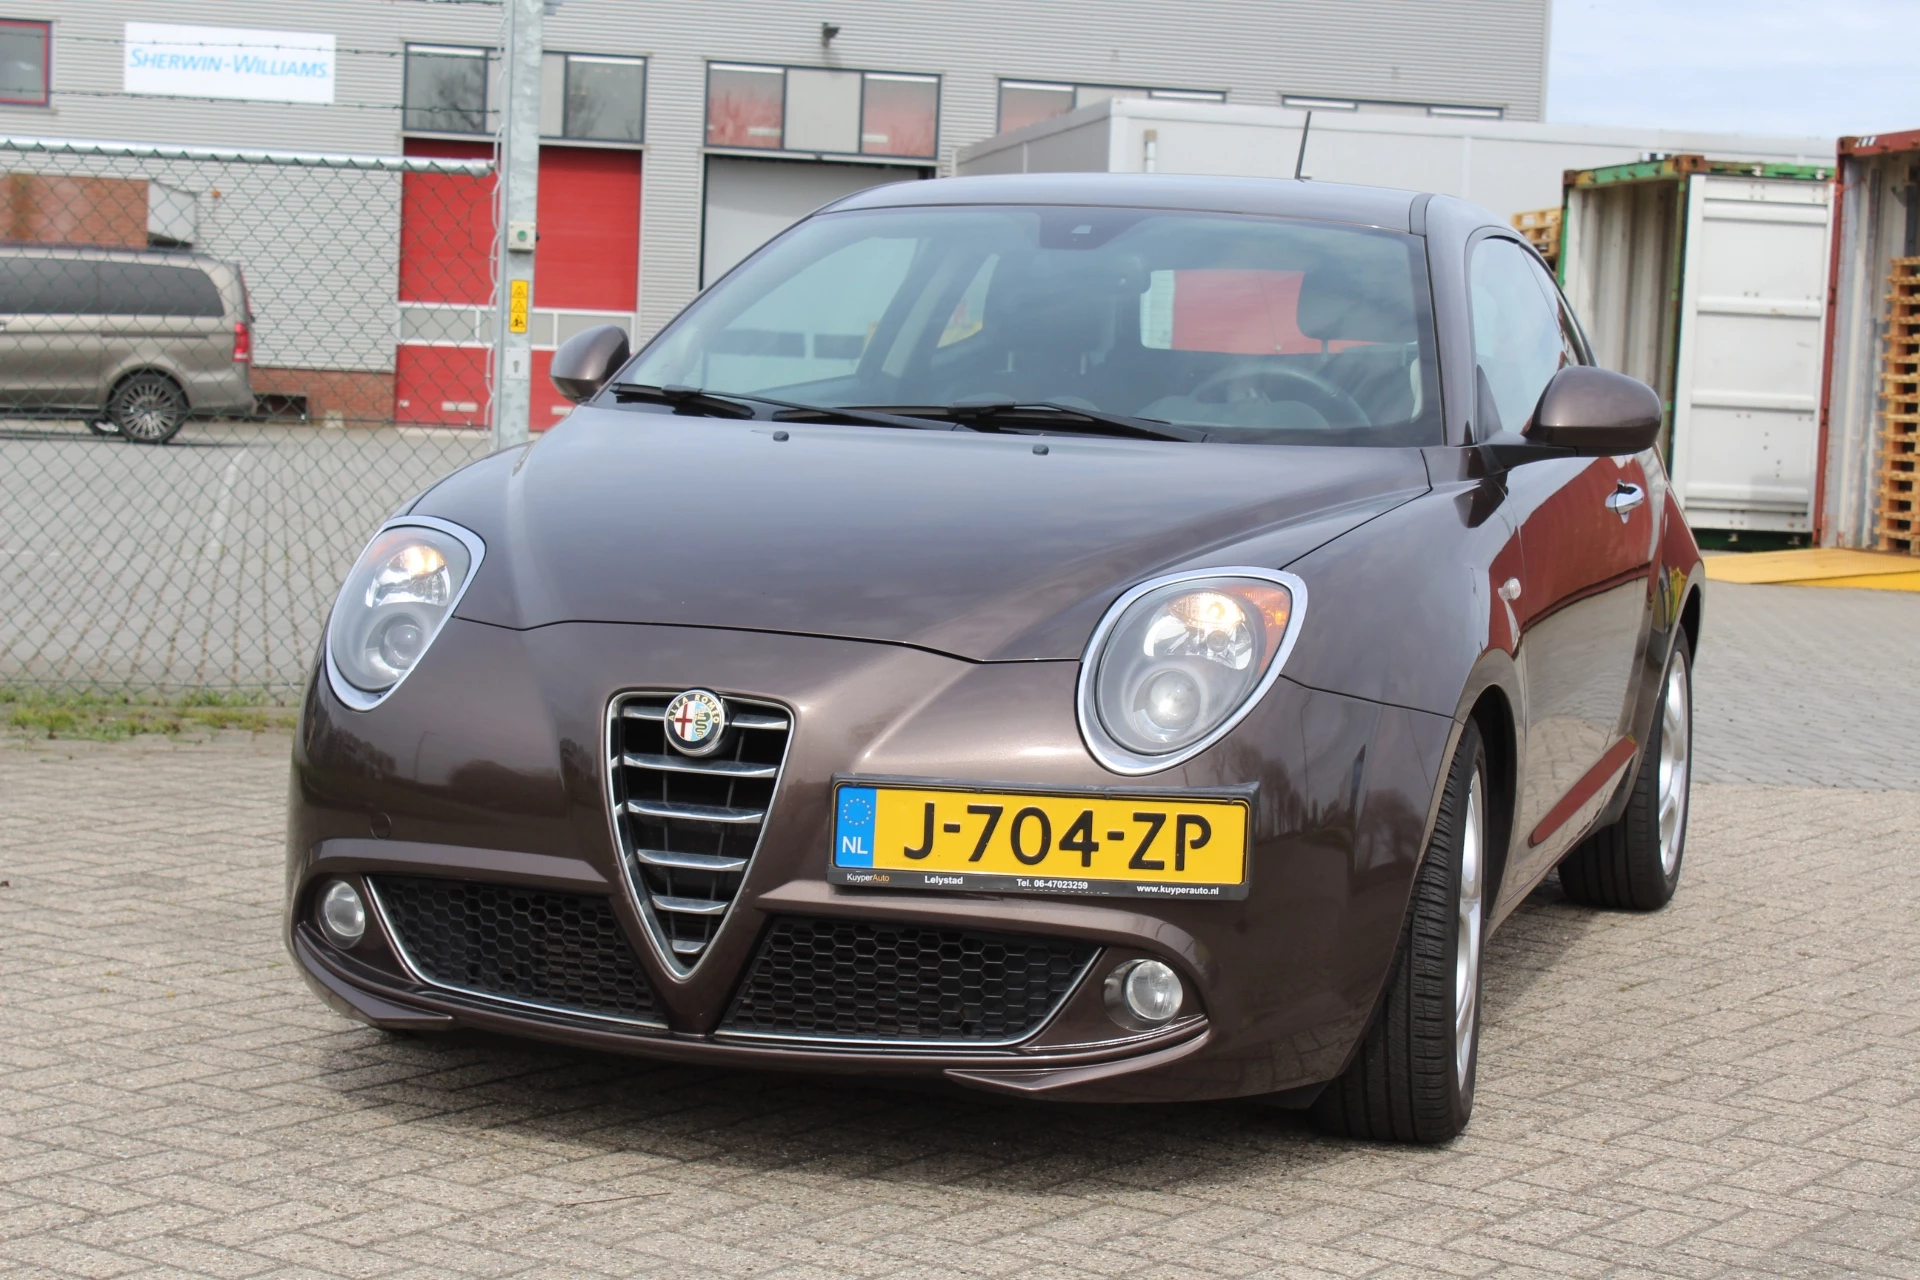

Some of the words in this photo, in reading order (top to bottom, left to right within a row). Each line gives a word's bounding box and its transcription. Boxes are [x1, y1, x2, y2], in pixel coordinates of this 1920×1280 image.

[668, 696, 689, 721] ALFA
[694, 694, 720, 724] ROMEO
[842, 836, 868, 854] NL
[904, 802, 1212, 871] J-704-ZP
[847, 873, 889, 883] KuyperAuto
[924, 875, 963, 885] Lelystad
[1016, 878, 1031, 887] Tel.
[1034, 879, 1088, 889] 06-47023259
[1136, 884, 1219, 895] www.kuyperauto.nl
